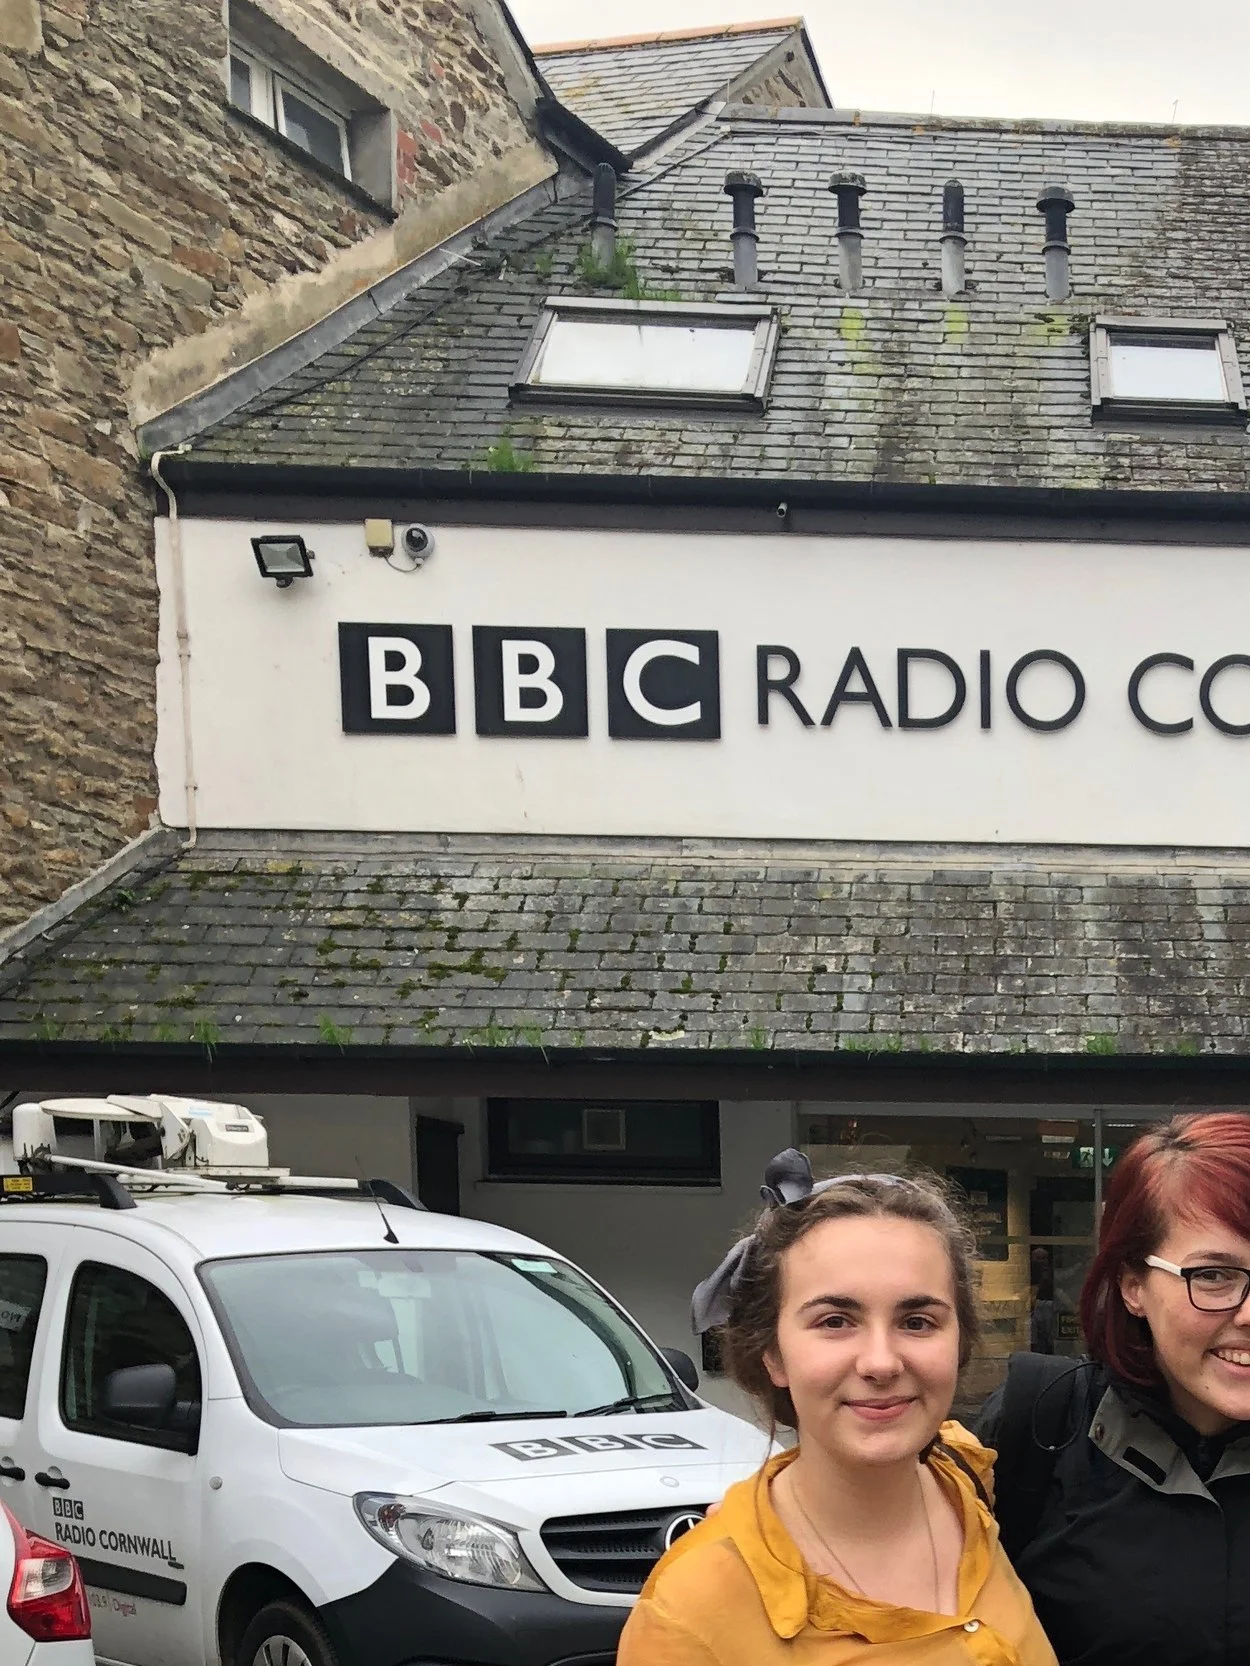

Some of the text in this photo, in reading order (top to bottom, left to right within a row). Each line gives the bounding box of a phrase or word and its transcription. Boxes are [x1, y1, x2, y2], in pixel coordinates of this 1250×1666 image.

[338, 622, 721, 739] BBC
[757, 644, 1086, 733] RADIO
[488, 1434, 708, 1461] BBC
[53, 1497, 84, 1520] BBC
[55, 1522, 176, 1561] RADIO CORNWALL
